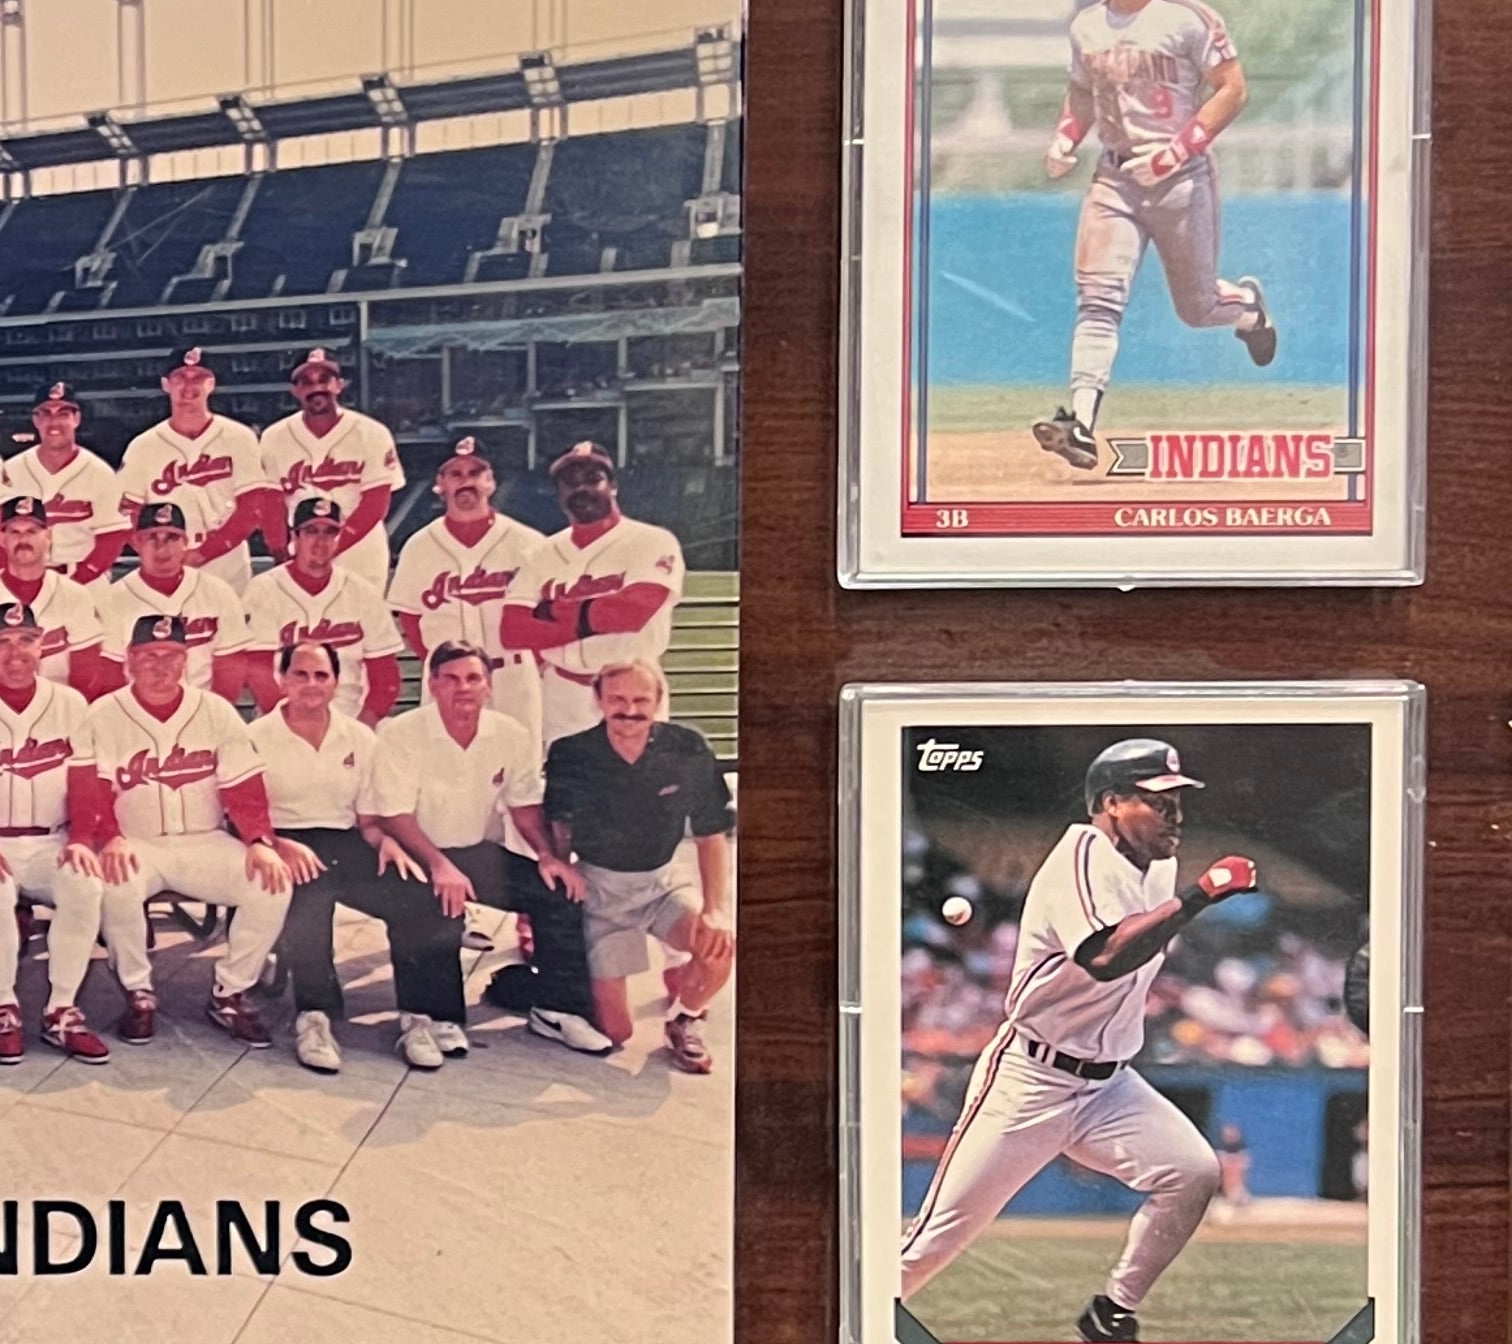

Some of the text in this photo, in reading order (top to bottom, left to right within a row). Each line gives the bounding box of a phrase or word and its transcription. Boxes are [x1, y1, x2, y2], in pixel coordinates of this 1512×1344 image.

[1149, 434, 1331, 479] INDIANS
[936, 509, 969, 528] 3B
[1114, 507, 1332, 527] CARLOS BAERGA
